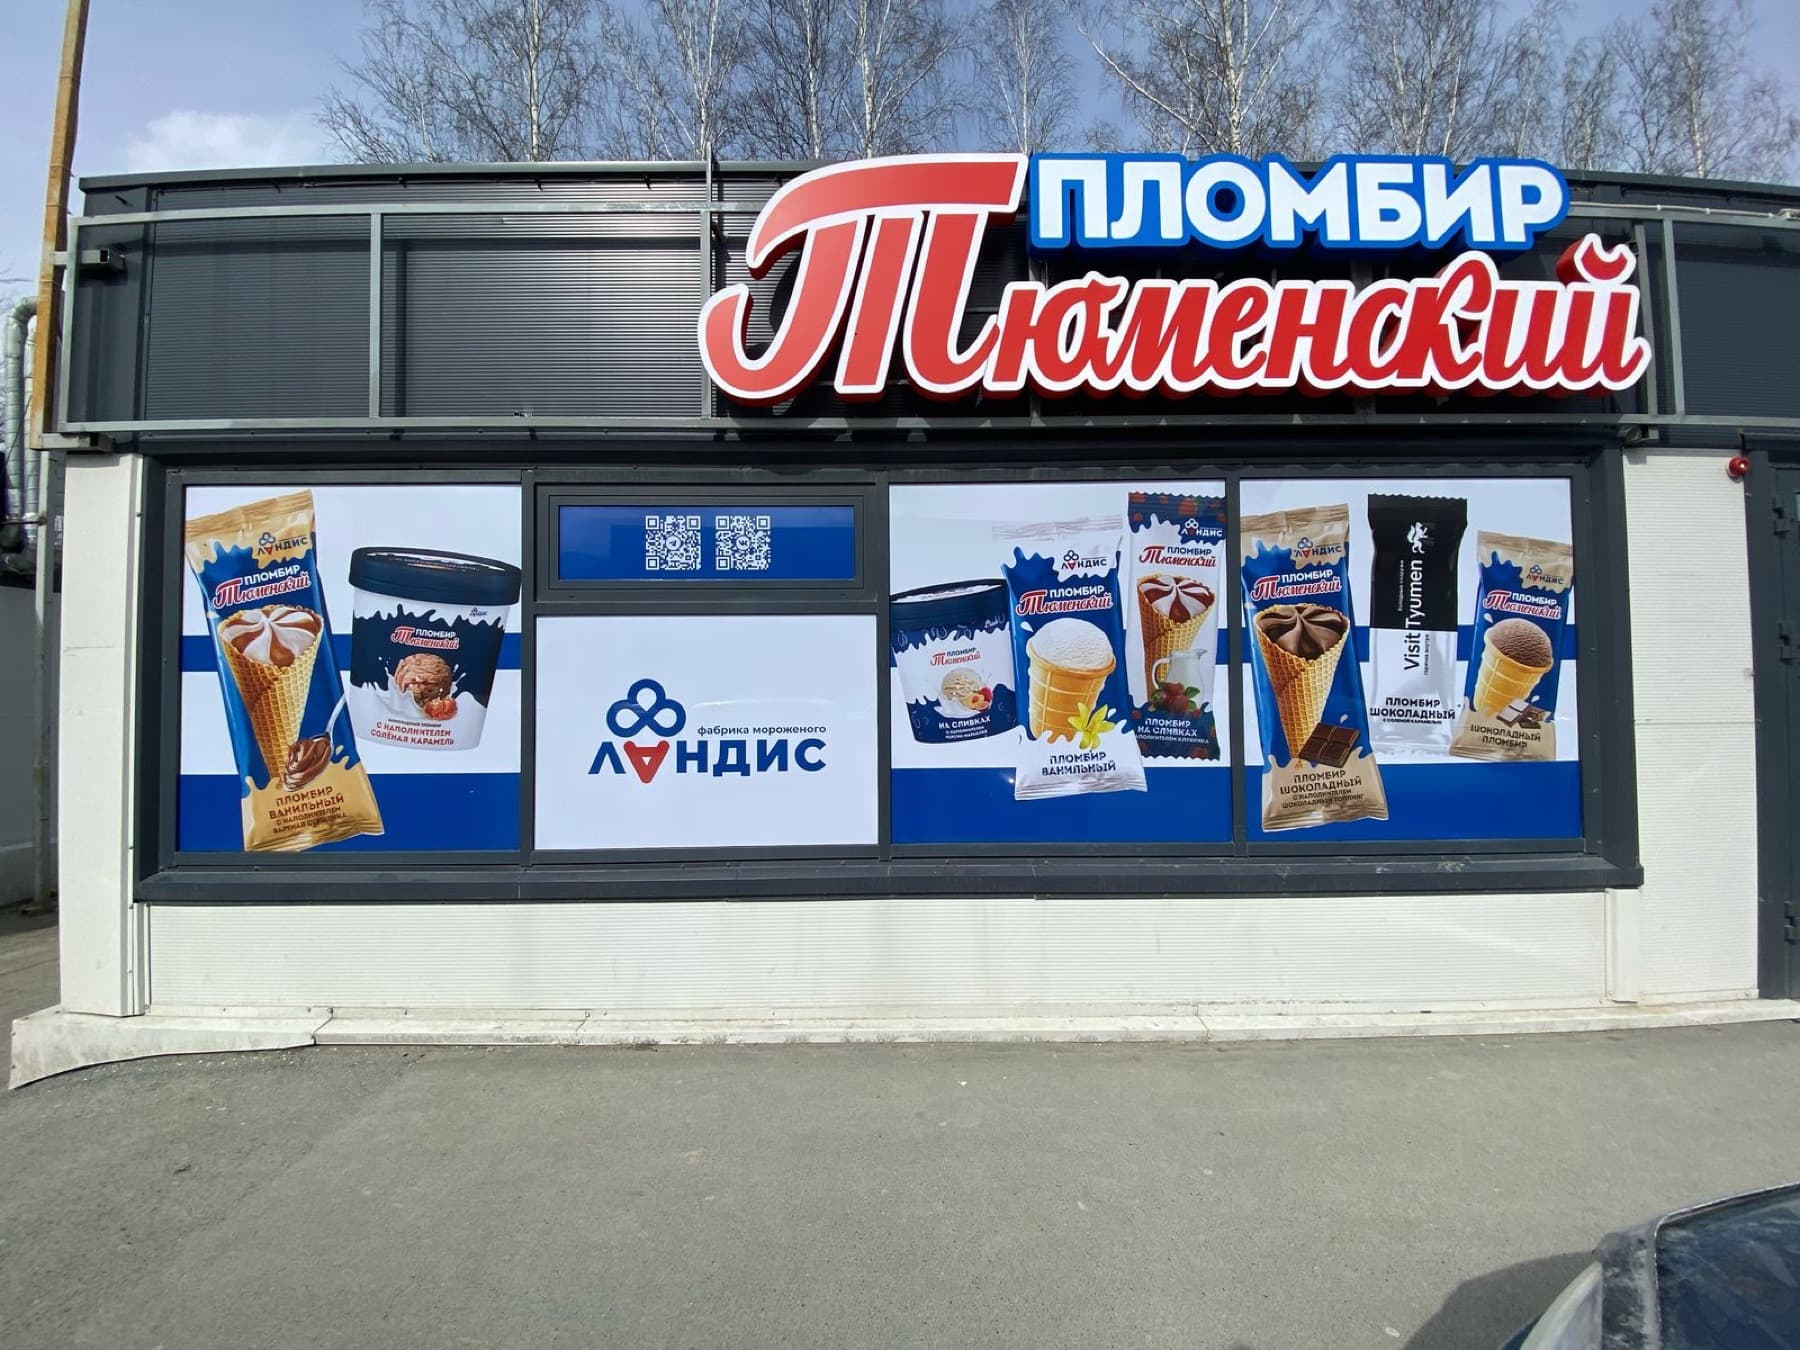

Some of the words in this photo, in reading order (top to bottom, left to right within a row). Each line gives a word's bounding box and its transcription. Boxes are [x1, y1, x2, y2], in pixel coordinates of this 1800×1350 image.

[1034, 160, 1567, 247] ПЛОМБИР
[697, 153, 1652, 403] Тюменский
[1180, 527, 1223, 538] ЛАНДИС
[1139, 545, 1218, 568] Тюменский
[1167, 545, 1212, 557] ПЛОМБИР
[1296, 546, 1342, 559] ЛАНДИС
[1060, 557, 1107, 570] ЛАНДИС
[244, 564, 301, 586] ПЛОМБИР
[1281, 569, 1334, 583] ПЛОМБИР
[212, 571, 312, 609] Тюменский
[1048, 585, 1106, 598] ПЛОМБИР
[1250, 575, 1342, 602] Тюменский
[1405, 559, 1426, 629] Tyumen
[1015, 589, 1114, 617] Тюменский
[1482, 589, 1562, 619] Тюменский
[1511, 593, 1557, 606] ПЛОМБИР
[390, 625, 460, 650] Тюменский
[415, 627, 457, 640] ПЛОМБИР
[946, 646, 977, 657] ПЛОМБИР
[1403, 633, 1421, 671] Visit
[1385, 697, 1441, 708] ПЛОМБИР
[1369, 707, 1456, 720] ШОКОЛАДНЫЙ
[376, 721, 382, 729] С
[938, 722, 951, 730] НА
[951, 714, 992, 729] СЛИВКАХ
[1144, 717, 1191, 729] ПЛОМБИР
[370, 728, 409, 743] СОЛЁНАЯ
[411, 736, 455, 746] КАРАМЕЛЬ
[697, 724, 750, 737] фабрика
[752, 724, 827, 736] мороженого
[1137, 726, 1151, 734] НА
[1152, 726, 1198, 738] СЛИВКАХ
[1470, 724, 1541, 742] ШОКОЛАДНЫЙ
[1482, 735, 1528, 748] ПЛОМБИР
[587, 738, 827, 784] ЛАНДИС
[1049, 751, 1107, 765] ПЛОМБИР
[1041, 760, 1117, 776] ВАНИЛЬНЫЙ
[1294, 770, 1347, 784] ПЛОМБИР
[1279, 776, 1362, 795] ШОКОЛАДНЫЙ
[276, 785, 333, 807] ПЛОМБИР
[268, 792, 344, 820] ВАНИЛЬНЫЙ
